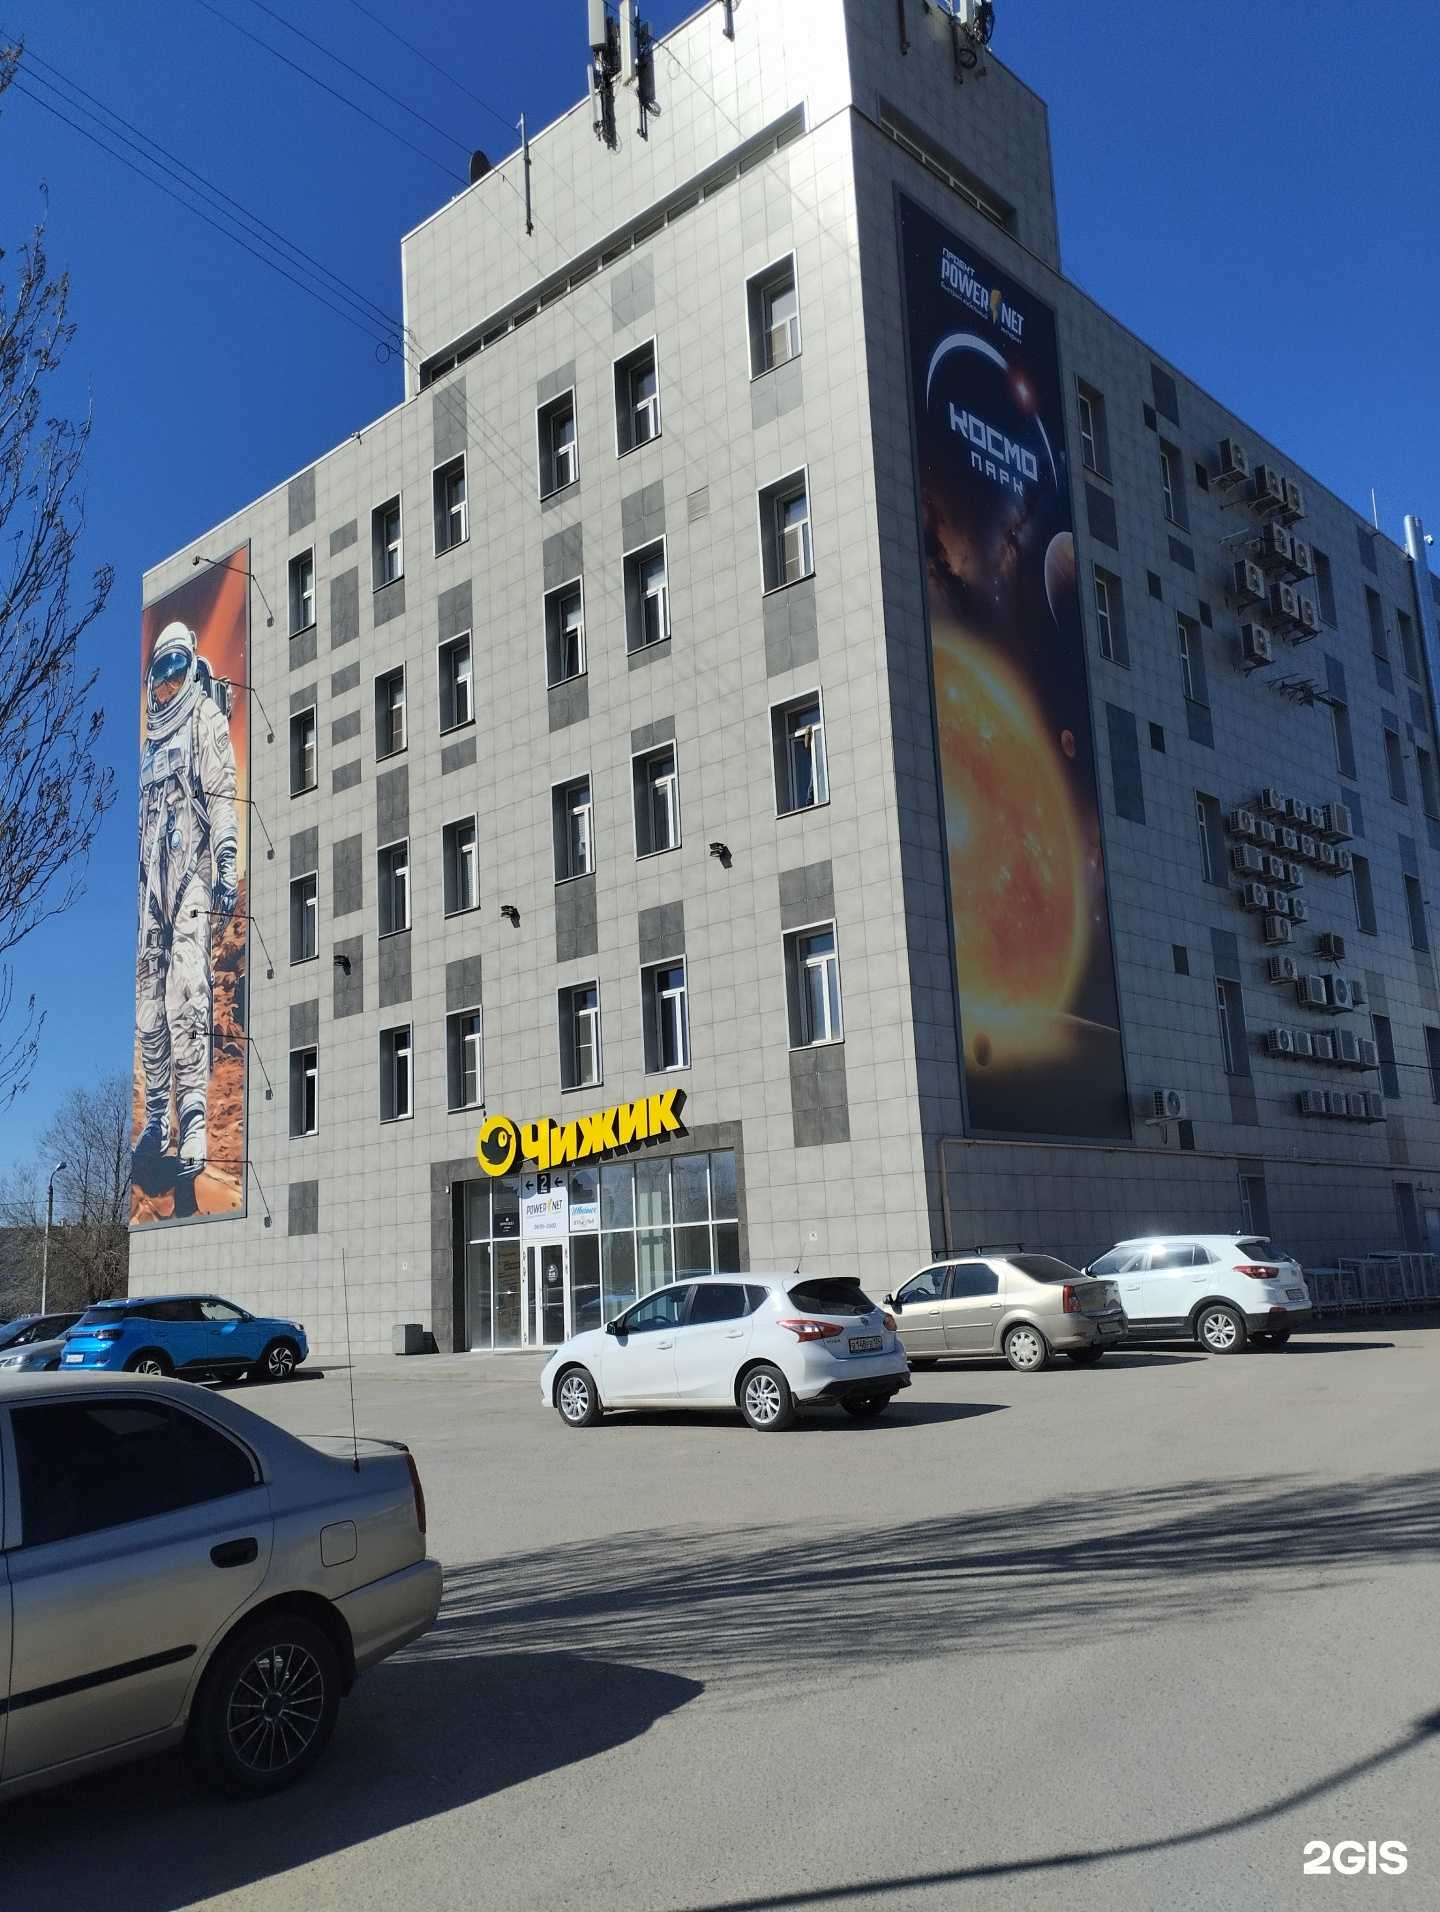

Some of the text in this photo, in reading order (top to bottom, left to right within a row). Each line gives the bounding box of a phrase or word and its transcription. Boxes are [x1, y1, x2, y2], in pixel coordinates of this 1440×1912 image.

[942, 257, 989, 312] POWER
[1001, 302, 1025, 336] NET
[949, 402, 1039, 482] КОСМО
[970, 451, 1024, 496] ПАРК
[540, 1175, 548, 1190] 2
[526, 1202, 547, 1215] POWER
[551, 1200, 563, 1211] NET
